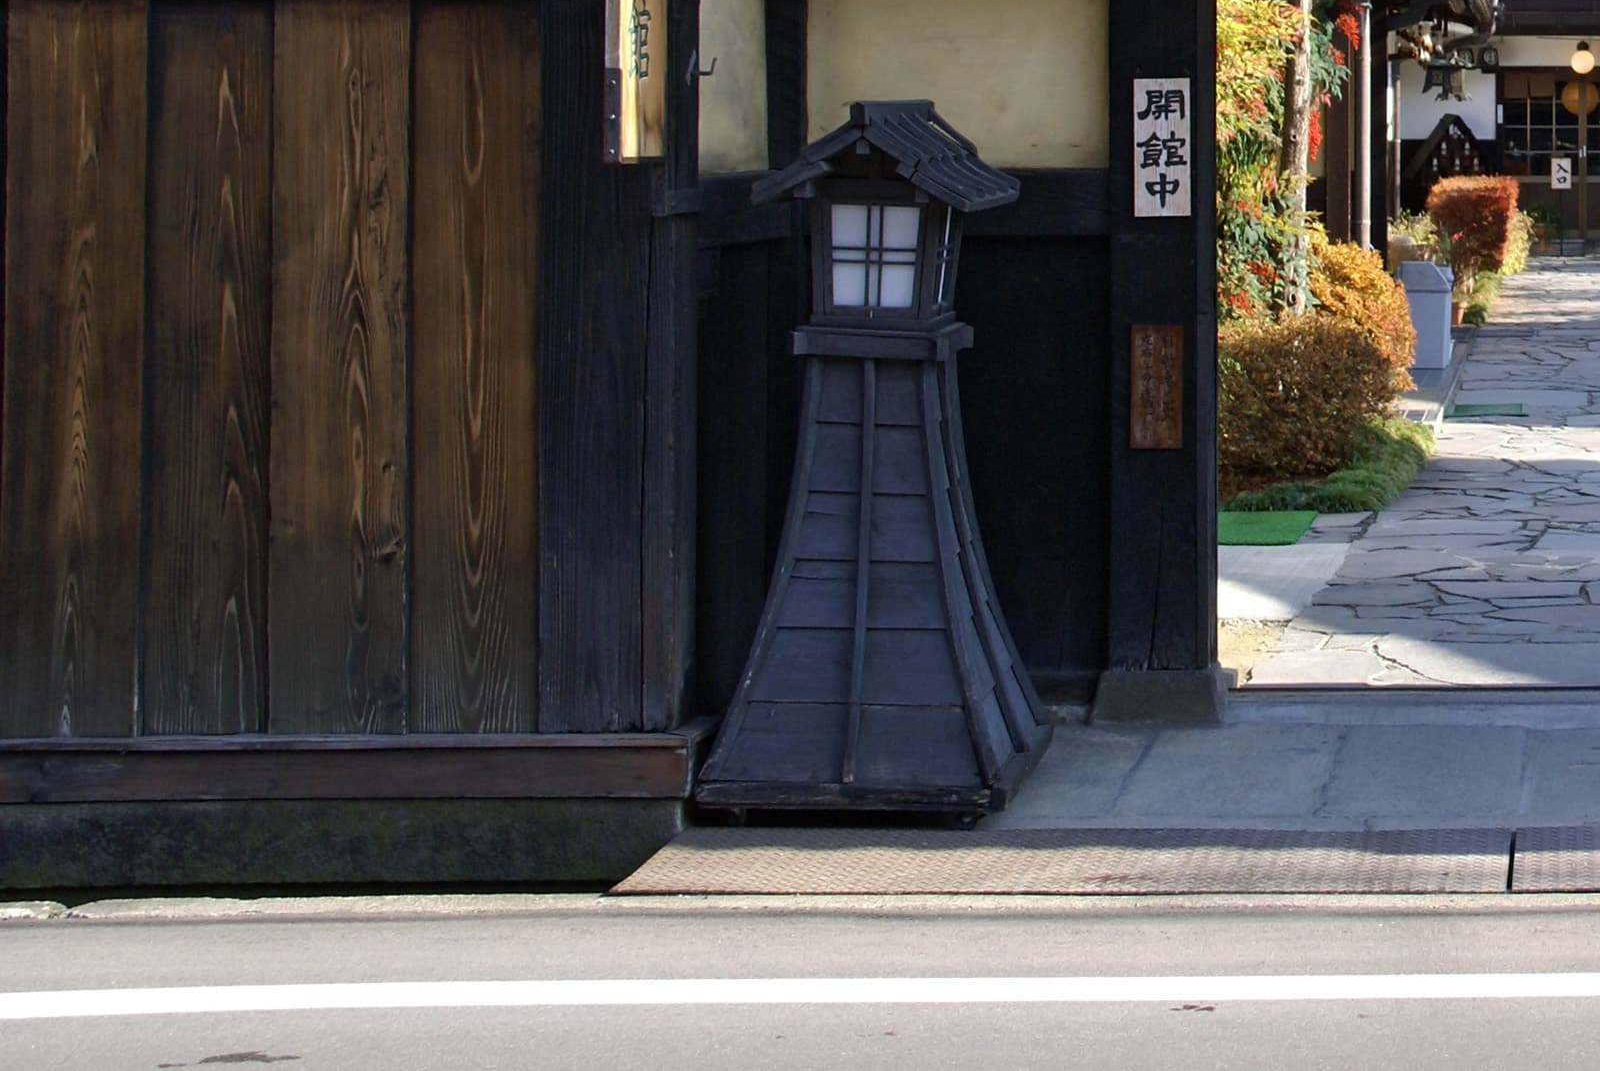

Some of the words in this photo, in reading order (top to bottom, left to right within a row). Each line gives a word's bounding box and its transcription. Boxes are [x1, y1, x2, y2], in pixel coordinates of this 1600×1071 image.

[1136, 89, 1188, 209] 開館中
[1556, 163, 1569, 184] 入口
